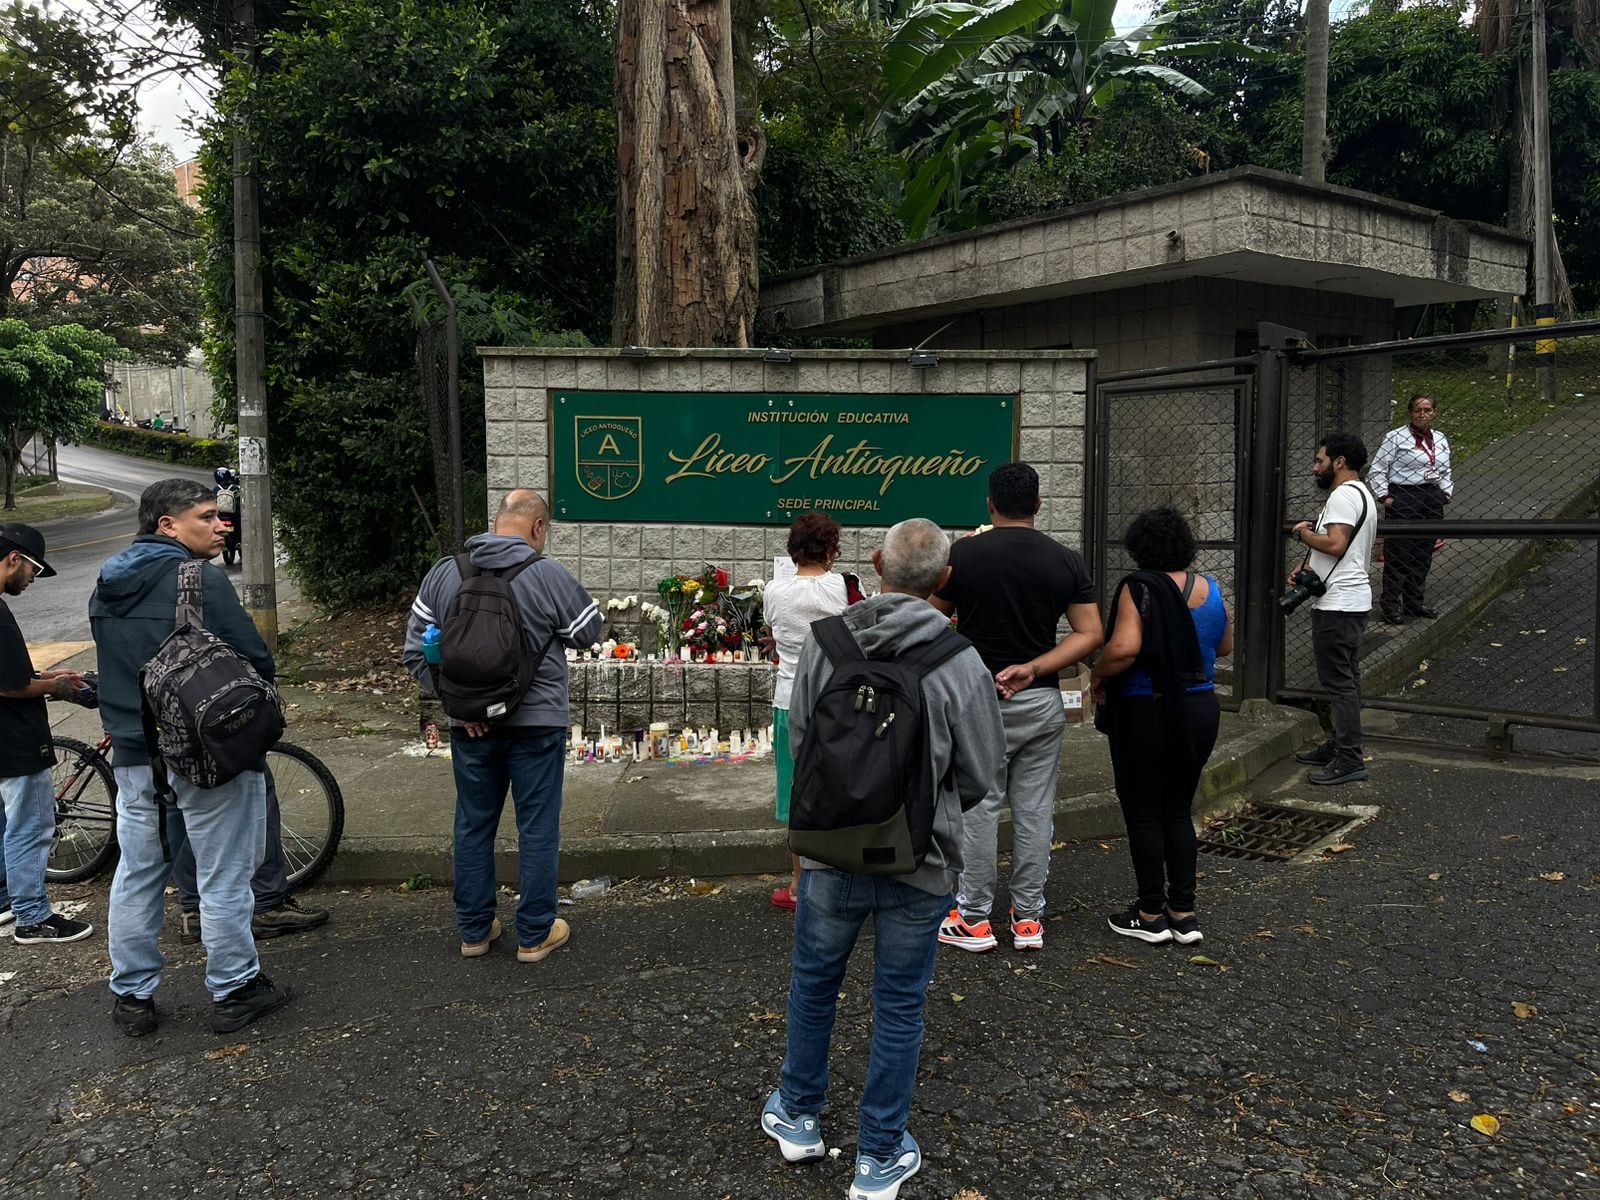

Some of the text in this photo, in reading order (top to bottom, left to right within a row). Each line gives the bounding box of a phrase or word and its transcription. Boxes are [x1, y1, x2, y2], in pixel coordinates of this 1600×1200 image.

[747, 410, 910, 424] INSTITUCIÓN EDUCATIVA
[598, 433, 621, 455] A
[665, 433, 988, 496] Liceo Antioqueño
[777, 498, 881, 511] SEDE PRINCIPAL
